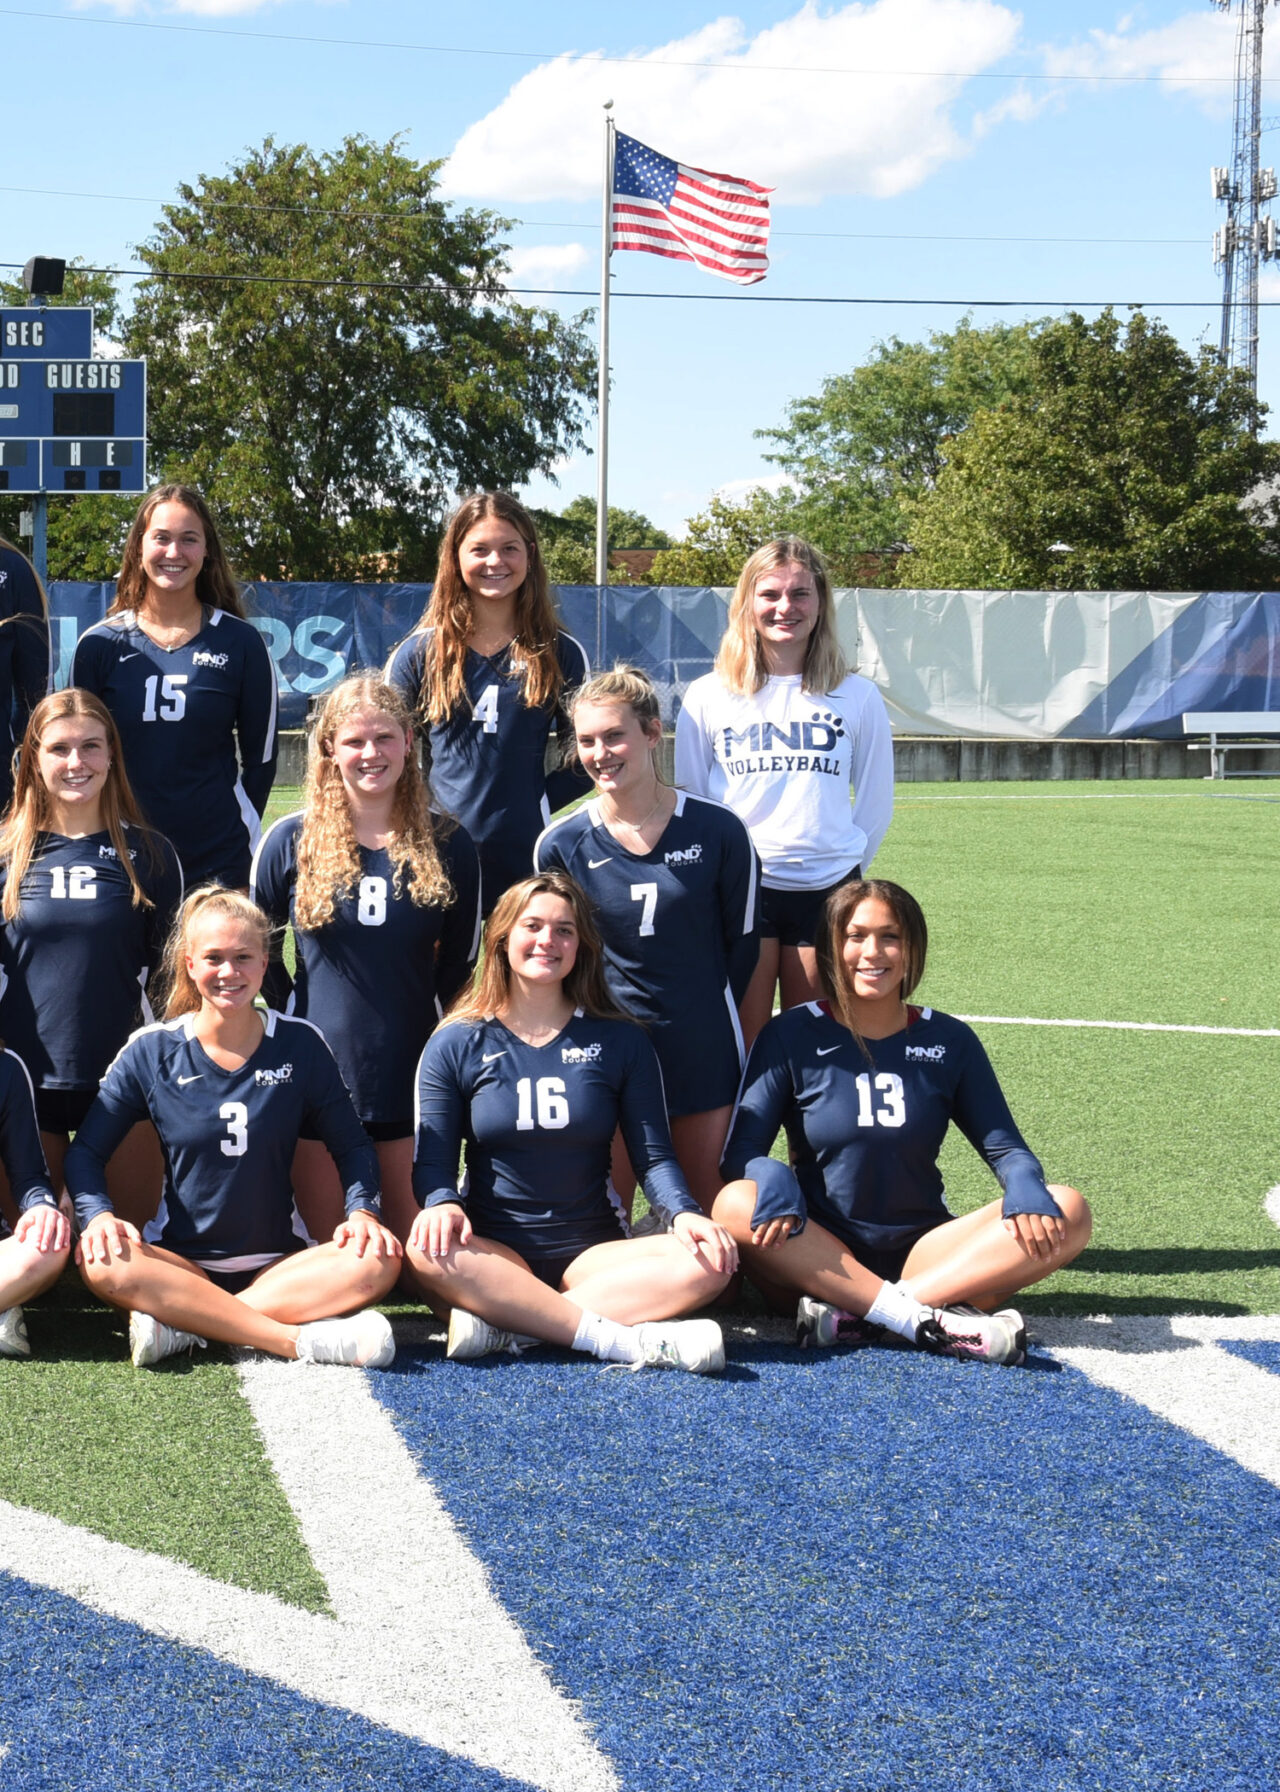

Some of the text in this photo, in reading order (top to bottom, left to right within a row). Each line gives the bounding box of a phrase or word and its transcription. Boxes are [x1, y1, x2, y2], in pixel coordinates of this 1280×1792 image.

[6, 322, 44, 346] SEC
[47, 364, 121, 388] GUESTS
[70, 442, 81, 466] H
[106, 442, 115, 466] E
[193, 652, 226, 666] MND
[142, 674, 188, 721] 15
[472, 685, 499, 733] 4
[723, 721, 837, 757] MND
[727, 756, 840, 776] VOLLEYBALL
[665, 849, 700, 863] MND
[50, 866, 97, 899] 12
[358, 876, 387, 926] 8
[630, 883, 658, 937] 7
[561, 1048, 600, 1059] MND
[905, 1046, 943, 1058] MND
[255, 1069, 290, 1082] MND
[516, 1077, 570, 1131] 16
[855, 1072, 906, 1127] 13
[219, 1102, 249, 1157] 3
